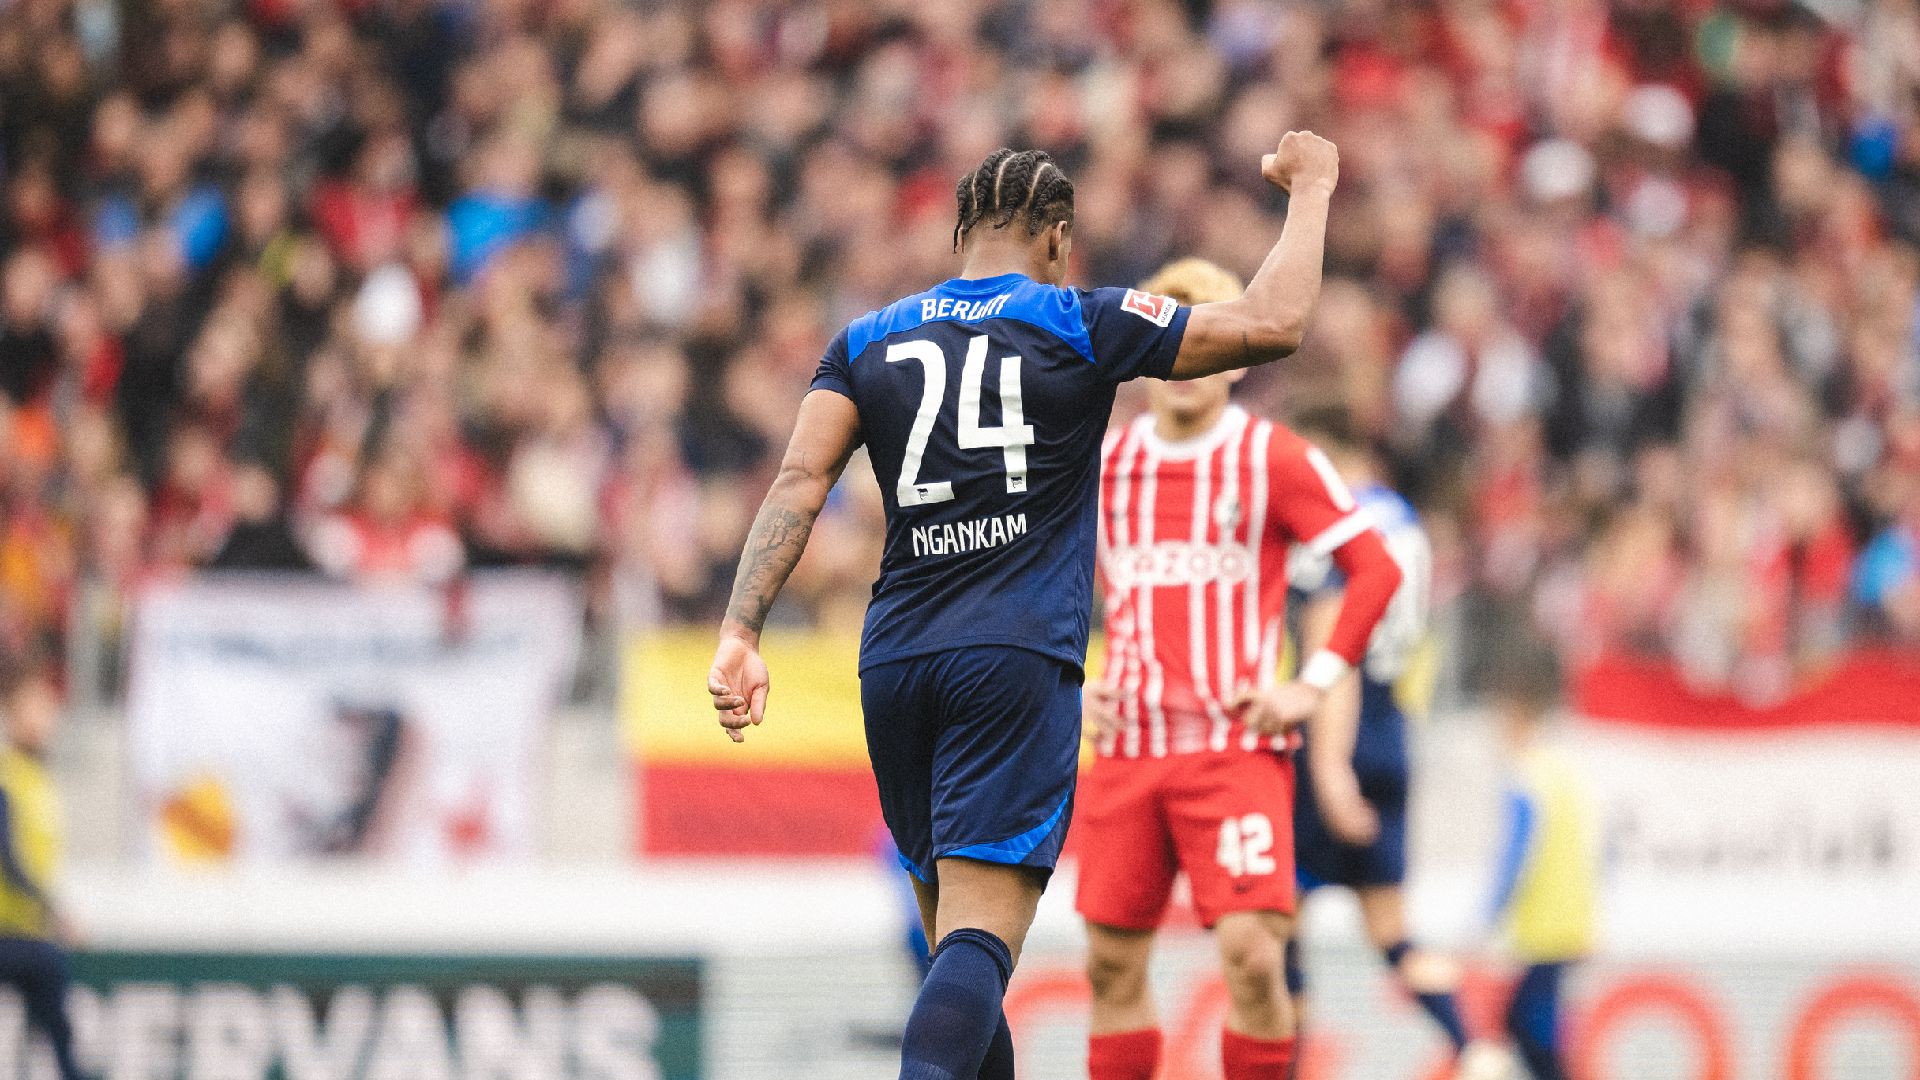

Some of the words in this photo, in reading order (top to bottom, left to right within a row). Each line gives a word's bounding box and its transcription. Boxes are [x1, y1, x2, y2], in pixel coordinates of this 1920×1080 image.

[921, 294, 1011, 322] BERLIN
[886, 334, 1035, 508] 24
[911, 512, 1028, 558] NGANKAM
[1216, 812, 1276, 877] 42
